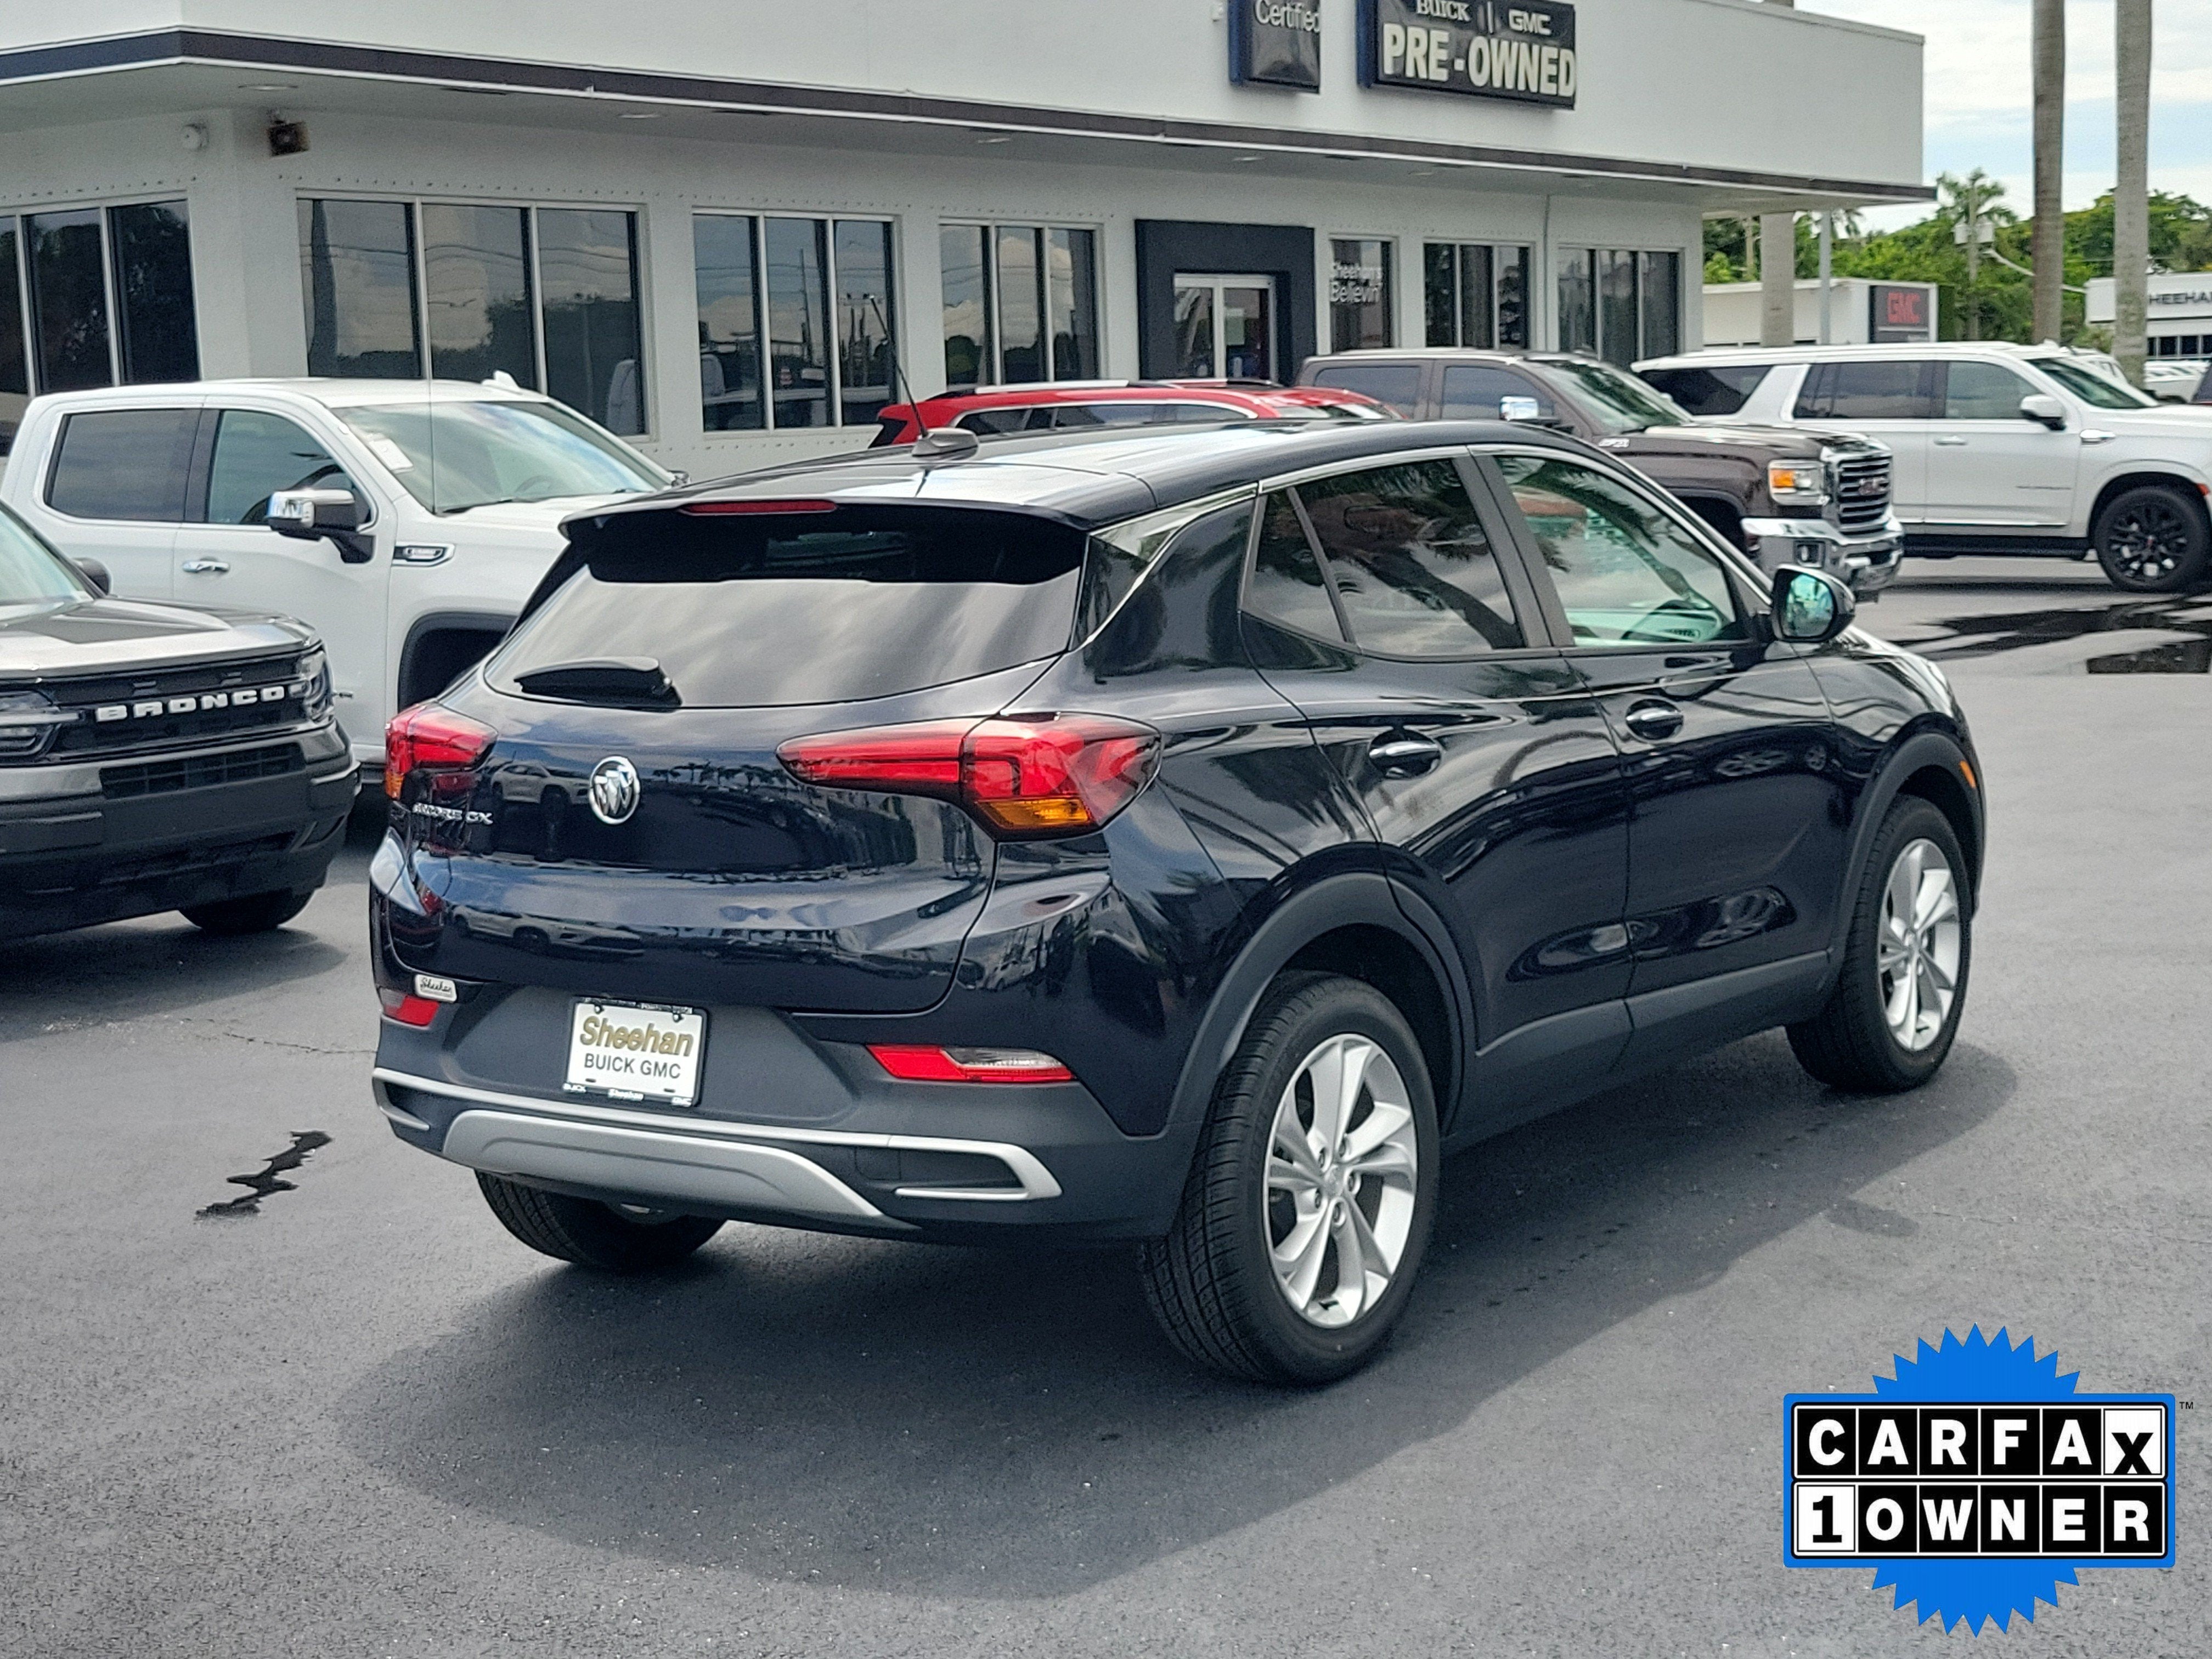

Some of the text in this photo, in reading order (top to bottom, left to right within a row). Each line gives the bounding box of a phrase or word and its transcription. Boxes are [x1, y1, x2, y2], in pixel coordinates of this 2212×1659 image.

[1417, 0, 1551, 36] BUICK GMC
[1383, 24, 1576, 97] PRE-OWNED
[2149, 292, 2212, 305] HEEHA
[95, 686, 285, 723] BRONCO
[465, 811, 493, 825] GX
[580, 1015, 694, 1057] Sheehan
[584, 1053, 681, 1079] BUICK GMC
